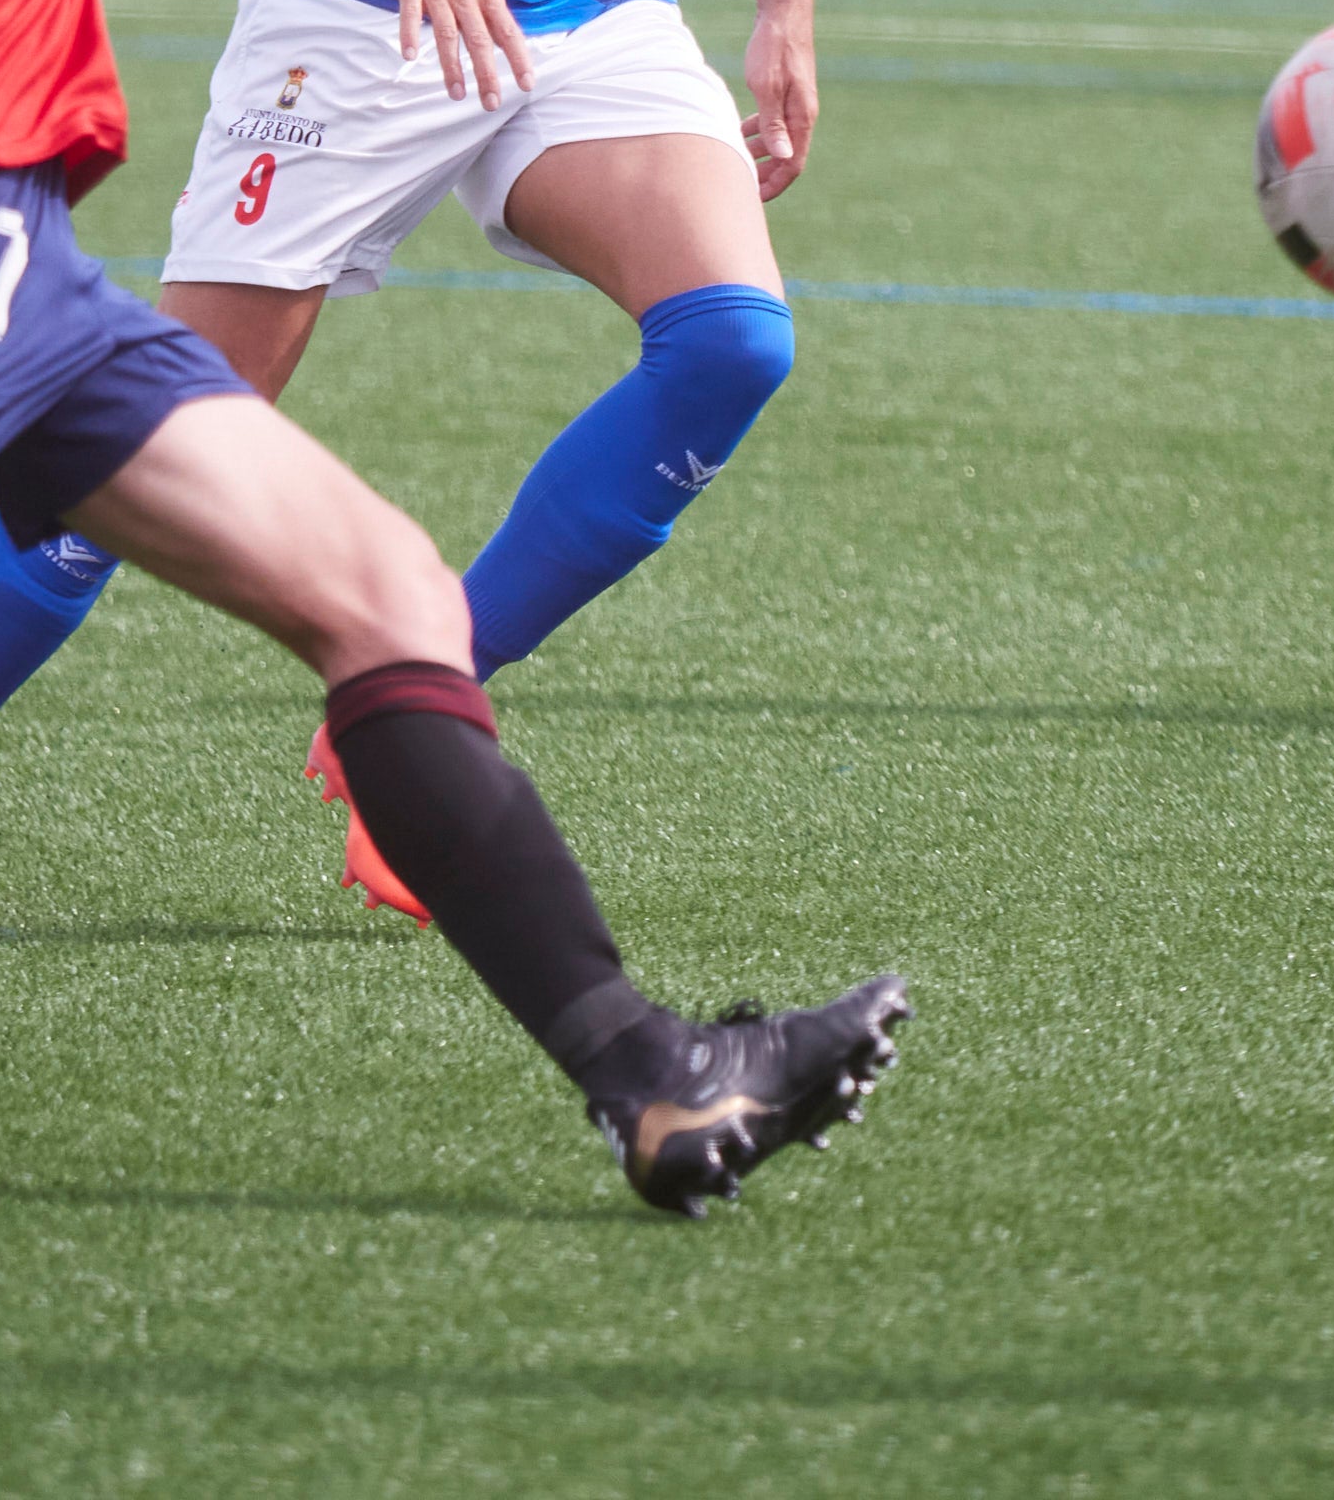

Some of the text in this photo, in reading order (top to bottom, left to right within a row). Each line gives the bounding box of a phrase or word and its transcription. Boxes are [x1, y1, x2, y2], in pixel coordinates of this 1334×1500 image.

[230, 116, 322, 148] LAREDO
[311, 120, 327, 133] DE
[234, 152, 276, 226] 9
